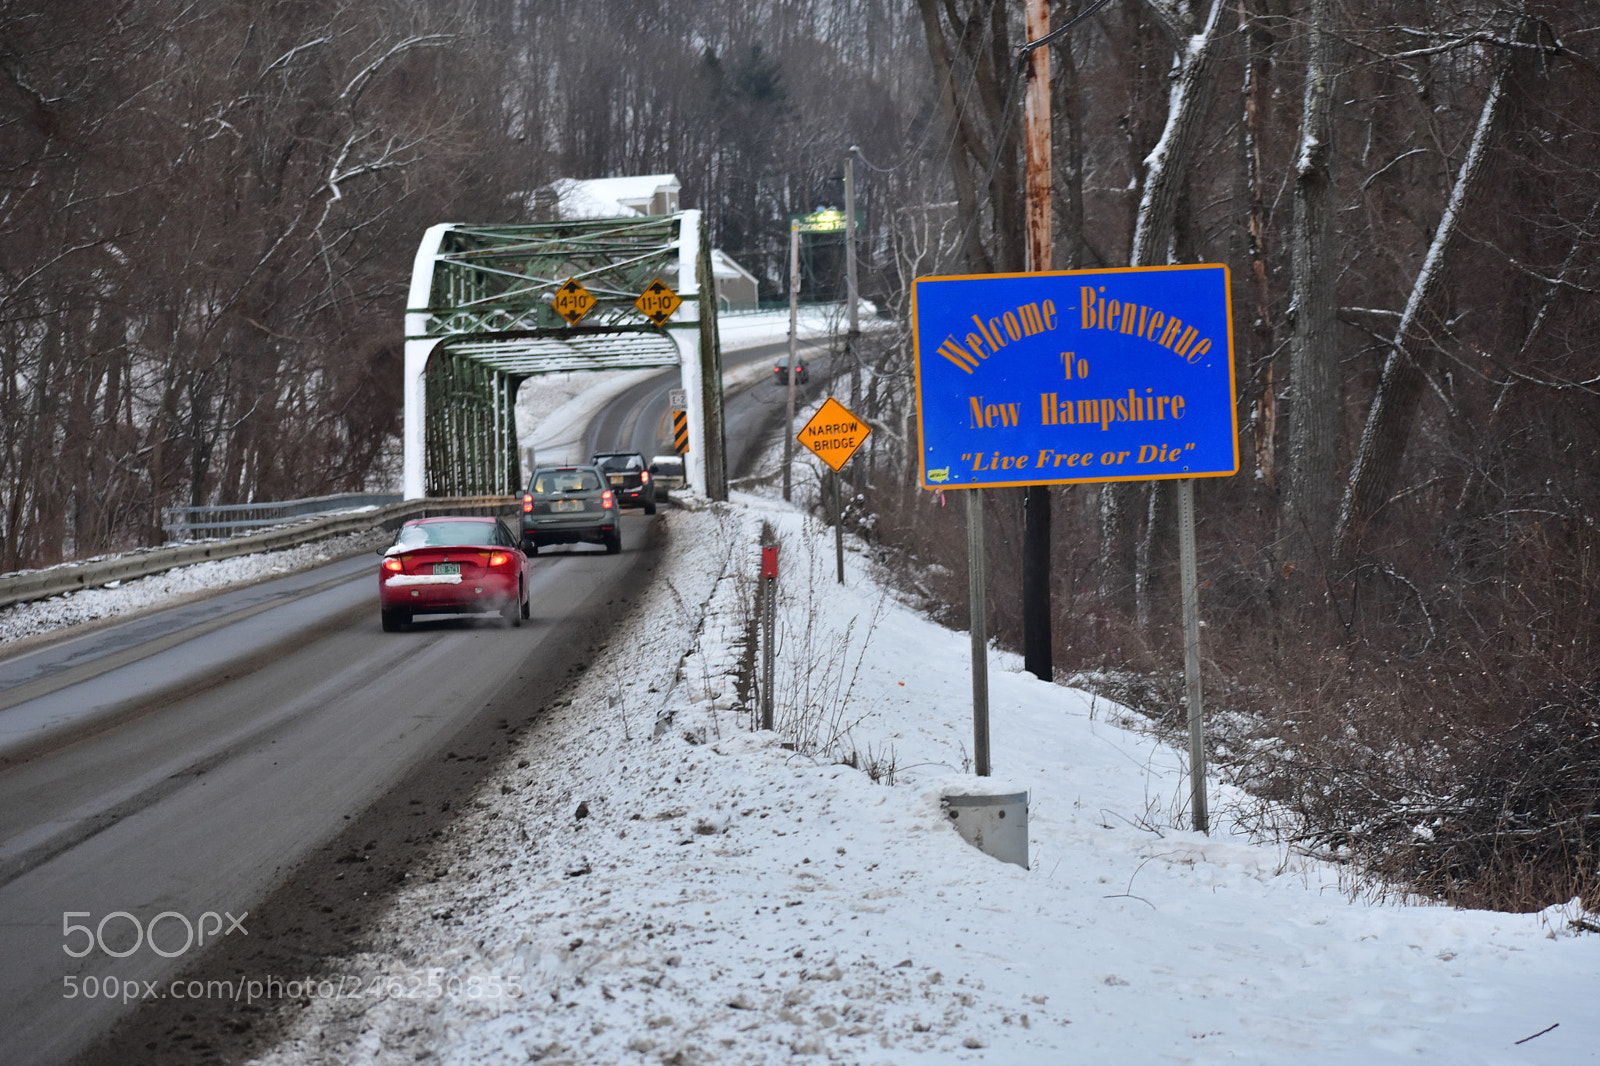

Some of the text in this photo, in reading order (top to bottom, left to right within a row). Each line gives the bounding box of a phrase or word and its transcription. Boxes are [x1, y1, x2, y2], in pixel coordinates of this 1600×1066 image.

[936, 298, 1058, 375] Welcome
[1080, 286, 1212, 364] Bienvenue
[1060, 351, 1089, 380] To
[968, 387, 1186, 431] New Hampshire
[808, 422, 858, 437] NARROW
[814, 437, 855, 452] BRIDGE
[961, 442, 1196, 471] "Live Free or Die"
